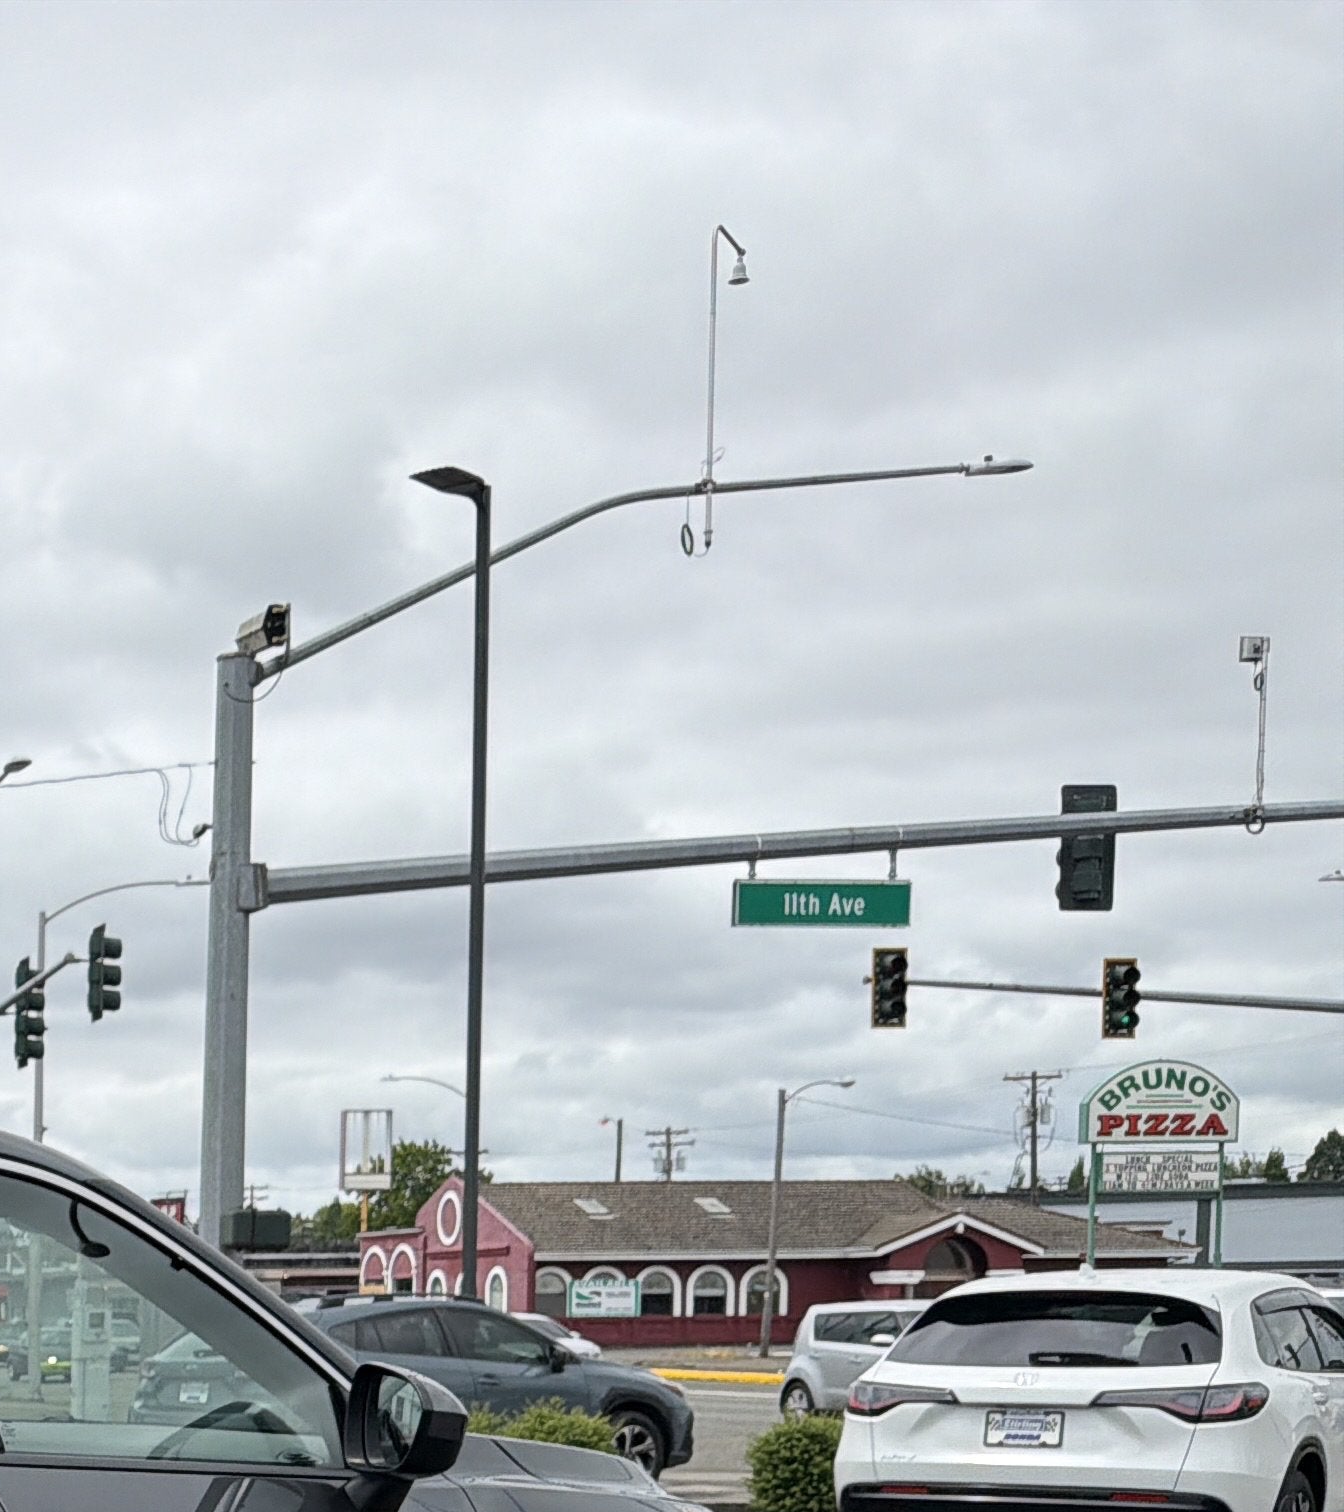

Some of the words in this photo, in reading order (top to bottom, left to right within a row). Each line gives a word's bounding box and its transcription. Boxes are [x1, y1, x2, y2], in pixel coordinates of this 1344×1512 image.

[784, 892, 820, 916] 11th
[828, 892, 866, 916] Ave
[1097, 1067, 1232, 1112] BRUNO'S
[1097, 1113, 1229, 1137] PIZZA
